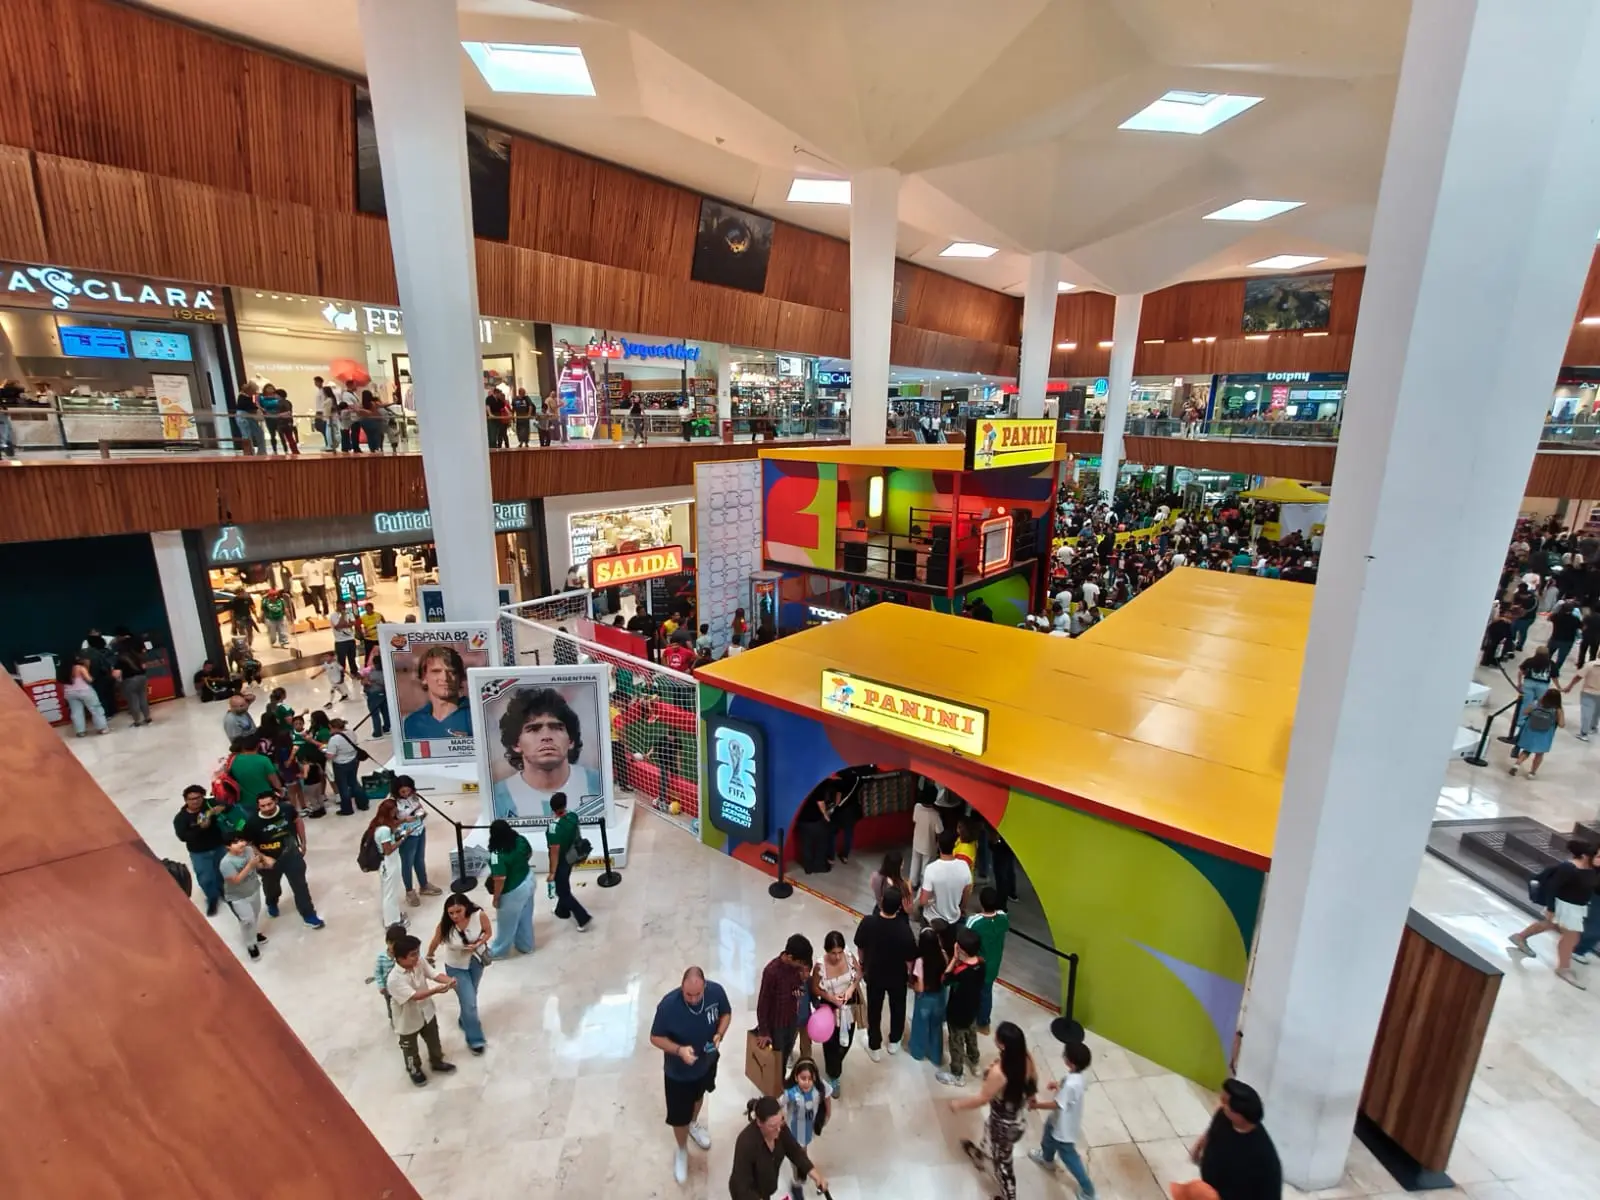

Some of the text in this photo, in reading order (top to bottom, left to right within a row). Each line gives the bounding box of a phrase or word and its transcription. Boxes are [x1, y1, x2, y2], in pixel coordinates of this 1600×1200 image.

[2, 271, 216, 310] A CLARA
[173, 309, 217, 321] 1924
[1001, 426, 1054, 447] PANINI
[596, 551, 680, 584] SALIDA
[407, 631, 469, 642] ESPAÑA 82
[864, 688, 975, 735] PANINI
[728, 786, 747, 800] FIFA
[722, 801, 751, 816] OFFICIAL
[722, 806, 752, 823] LICENSED
[722, 812, 752, 829] PRODUCT
